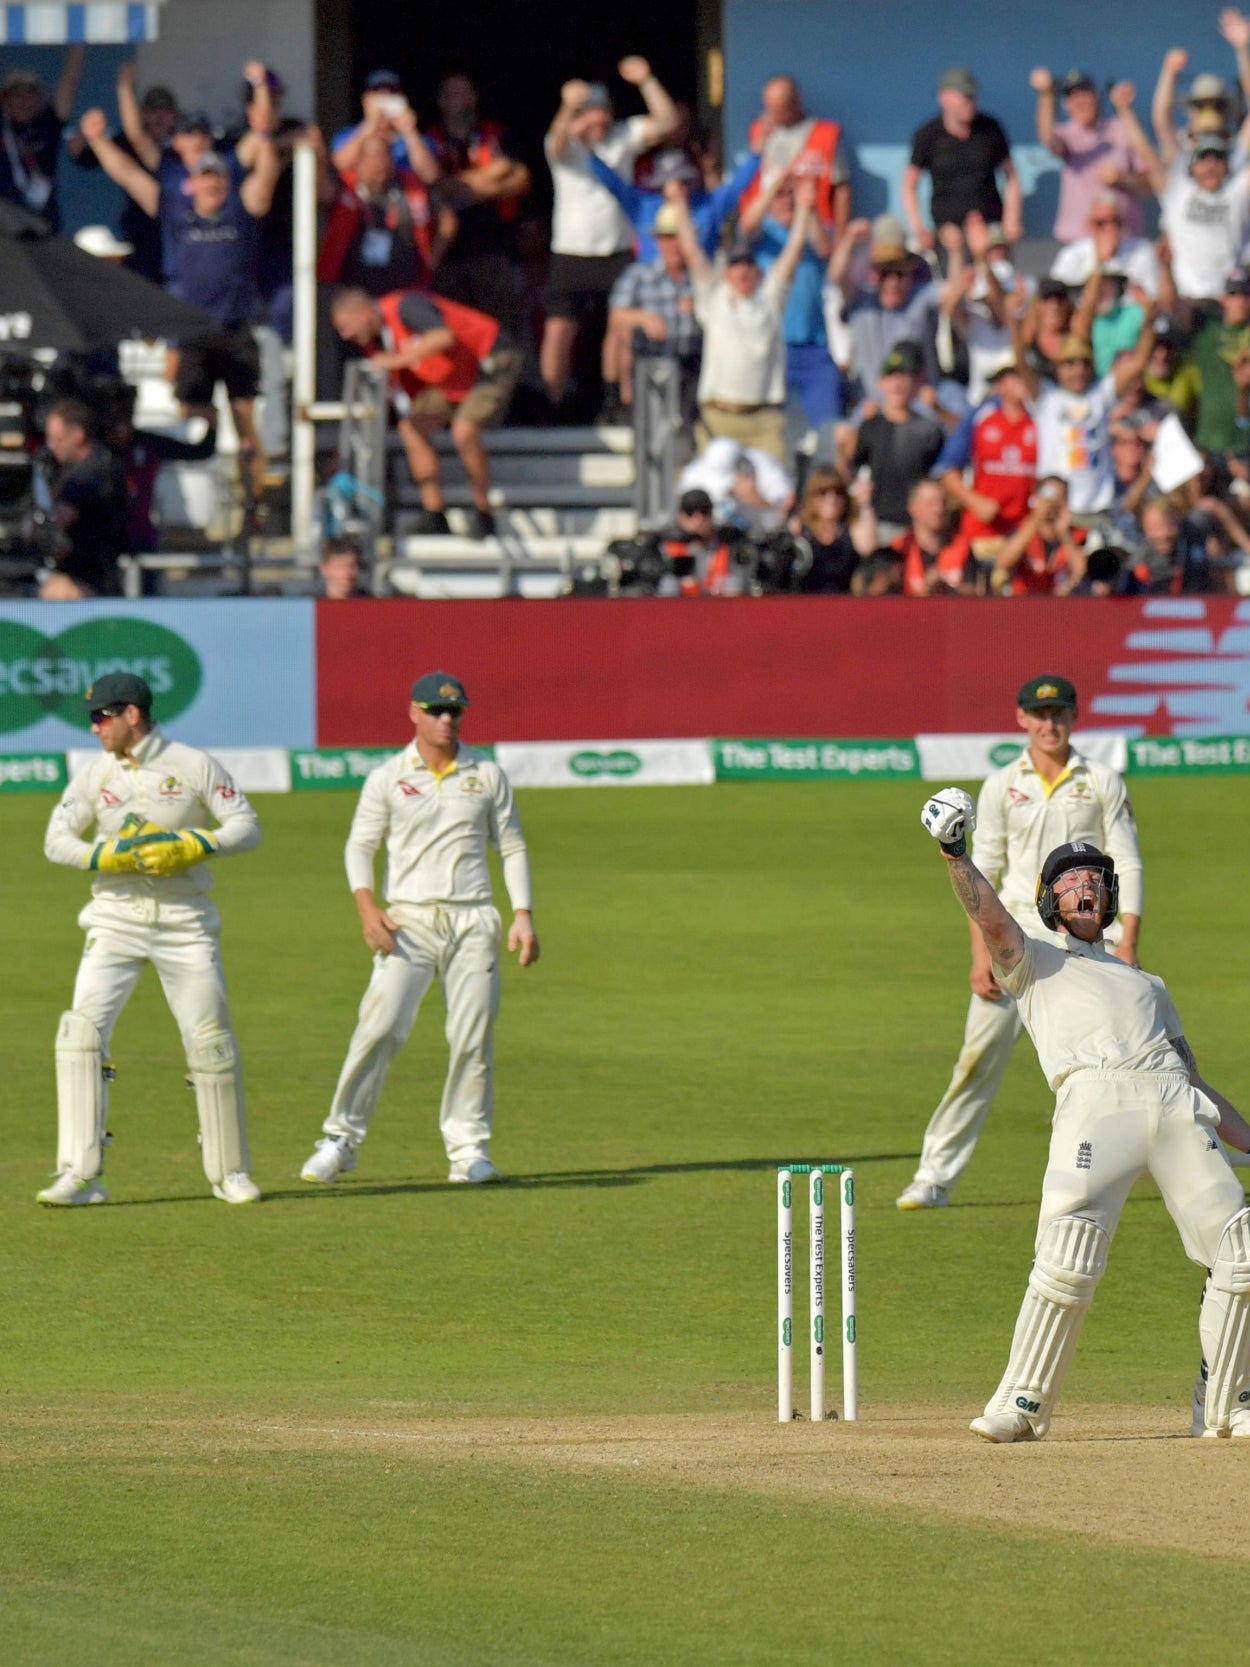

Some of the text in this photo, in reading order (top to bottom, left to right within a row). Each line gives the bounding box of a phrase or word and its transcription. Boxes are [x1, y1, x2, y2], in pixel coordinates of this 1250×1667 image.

[721, 742, 914, 774] The Test Experts
[1134, 740, 1180, 766] The
[1182, 740, 1231, 765] Test
[295, 754, 344, 780] The
[814, 1215, 823, 1235] The
[782, 1231, 792, 1295] Specsavers
[814, 1239, 824, 1261] Test
[845, 1229, 855, 1292] Specsavers
[813, 1263, 824, 1307] Experts
[1015, 1396, 1041, 1414] GM
